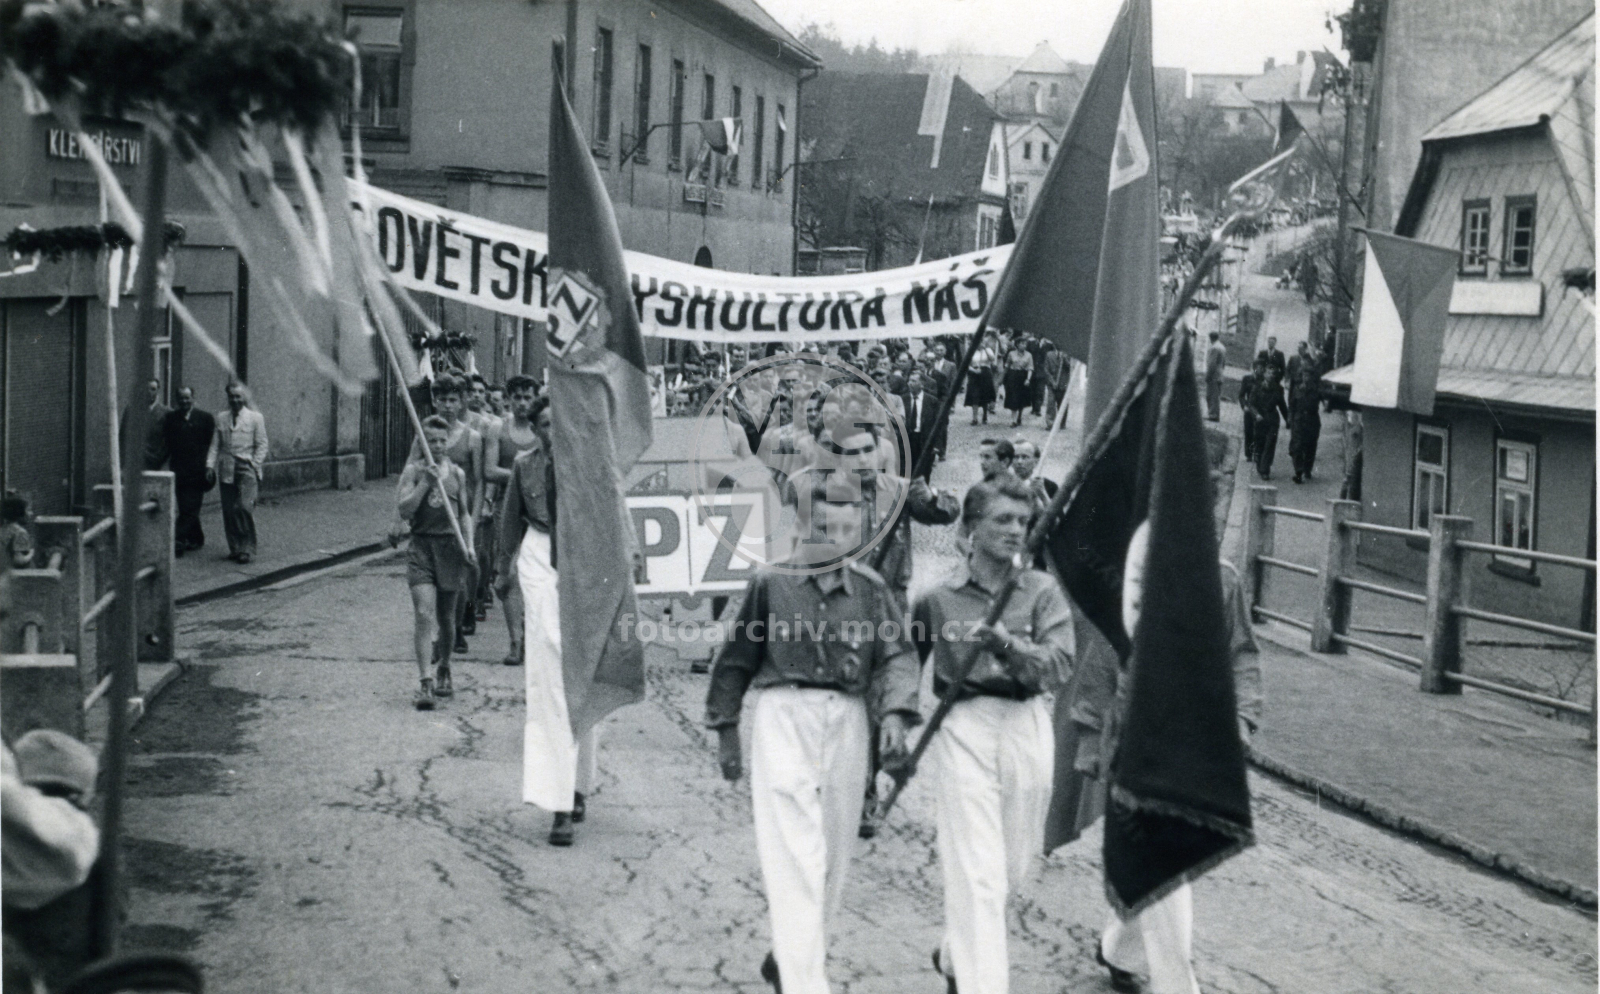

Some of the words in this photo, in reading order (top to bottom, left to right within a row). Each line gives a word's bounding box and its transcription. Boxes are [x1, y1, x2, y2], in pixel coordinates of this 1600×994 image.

[351, 201, 548, 308] OVĚTSK
[631, 273, 887, 331] YSKULTURA
[903, 256, 996, 325] NÁŠ
